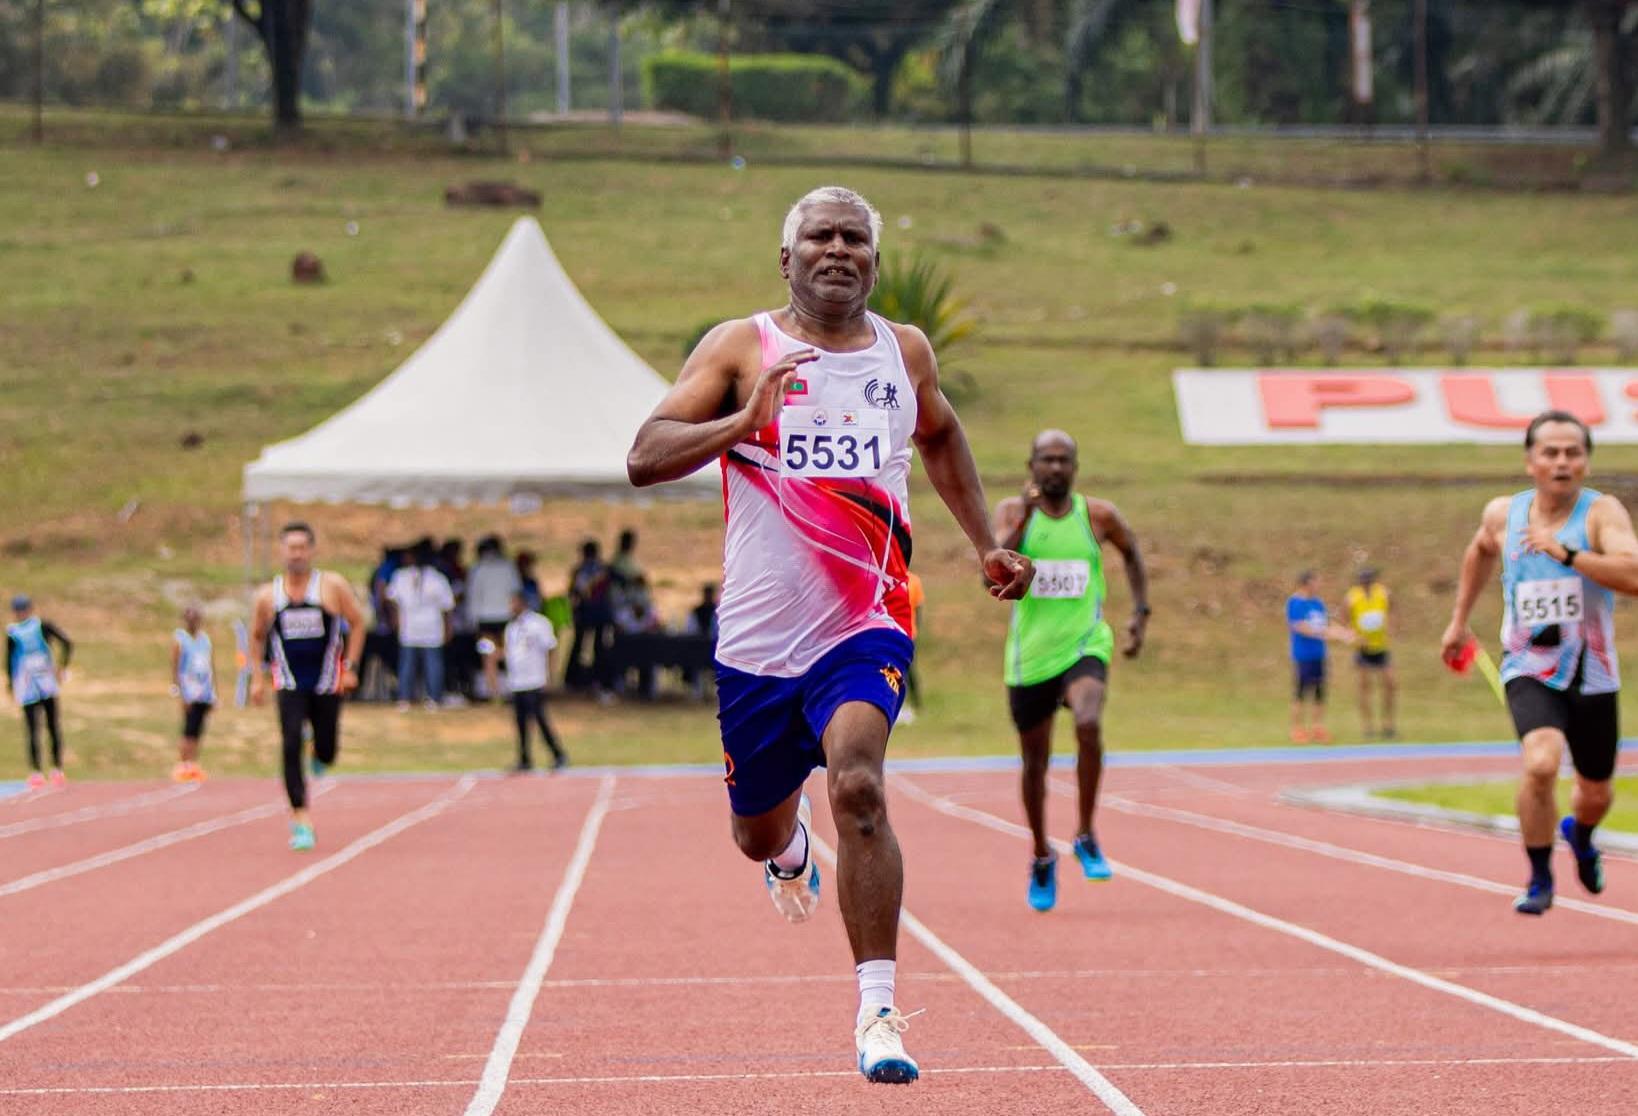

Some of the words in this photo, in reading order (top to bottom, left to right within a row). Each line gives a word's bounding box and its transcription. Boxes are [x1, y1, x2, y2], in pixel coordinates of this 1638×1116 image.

[1257, 371, 1638, 428] PU
[786, 434, 880, 470] 5531
[1522, 595, 1581, 619] 5515
